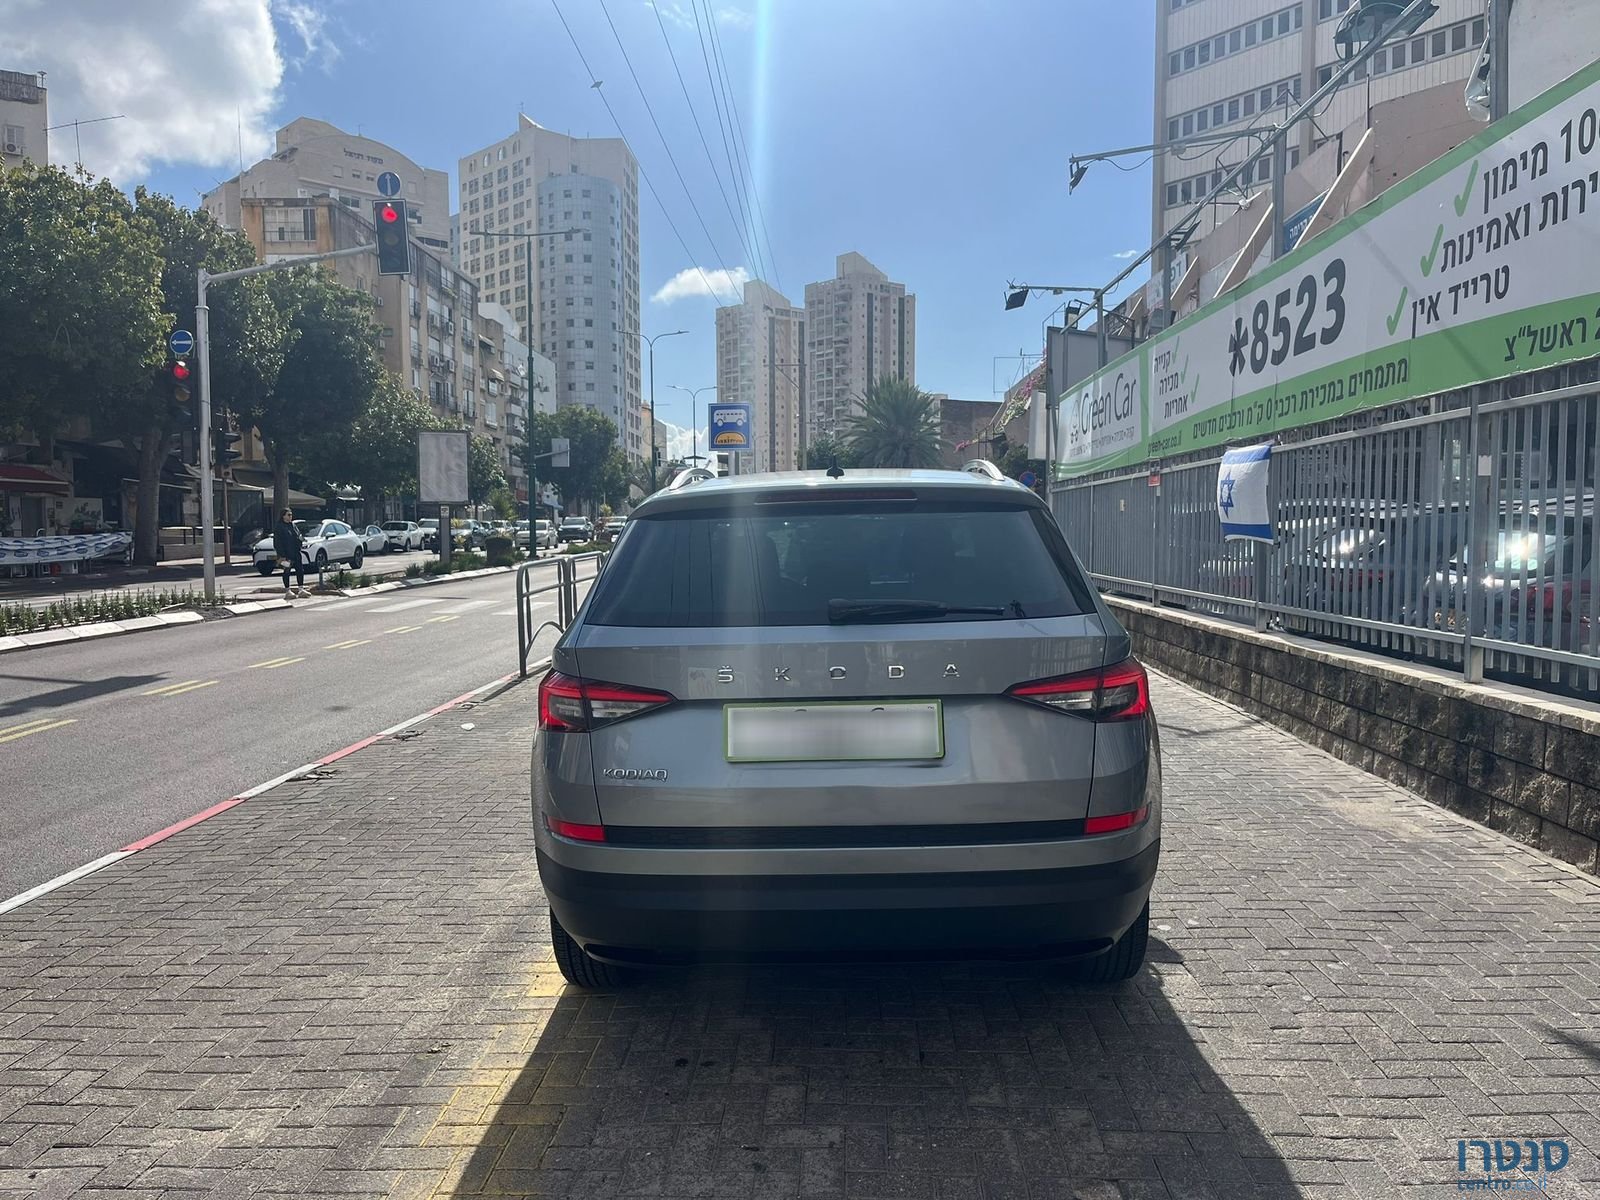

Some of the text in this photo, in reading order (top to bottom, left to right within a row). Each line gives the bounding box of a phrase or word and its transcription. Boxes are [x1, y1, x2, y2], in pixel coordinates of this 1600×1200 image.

[1483, 108, 1600, 214] 10 מימון
[1441, 171, 1600, 273] ירות ואמינות
[1411, 265, 1510, 339] טרייד אין
[1153, 350, 1171, 374] קנייה
[1159, 372, 1179, 396] מכירה
[1348, 358, 1409, 397] מתמחים
[1080, 373, 1137, 436] Green Car
[1164, 394, 1189, 419] אחריות
[1300, 379, 1344, 412] במכירת
[1193, 417, 1217, 440] חדשים
[1218, 409, 1245, 433] ורכבים
[1147, 430, 1182, 457] green-car.co.il
[717, 664, 961, 683] ŠKODA
[602, 768, 669, 782] KODIAQ
